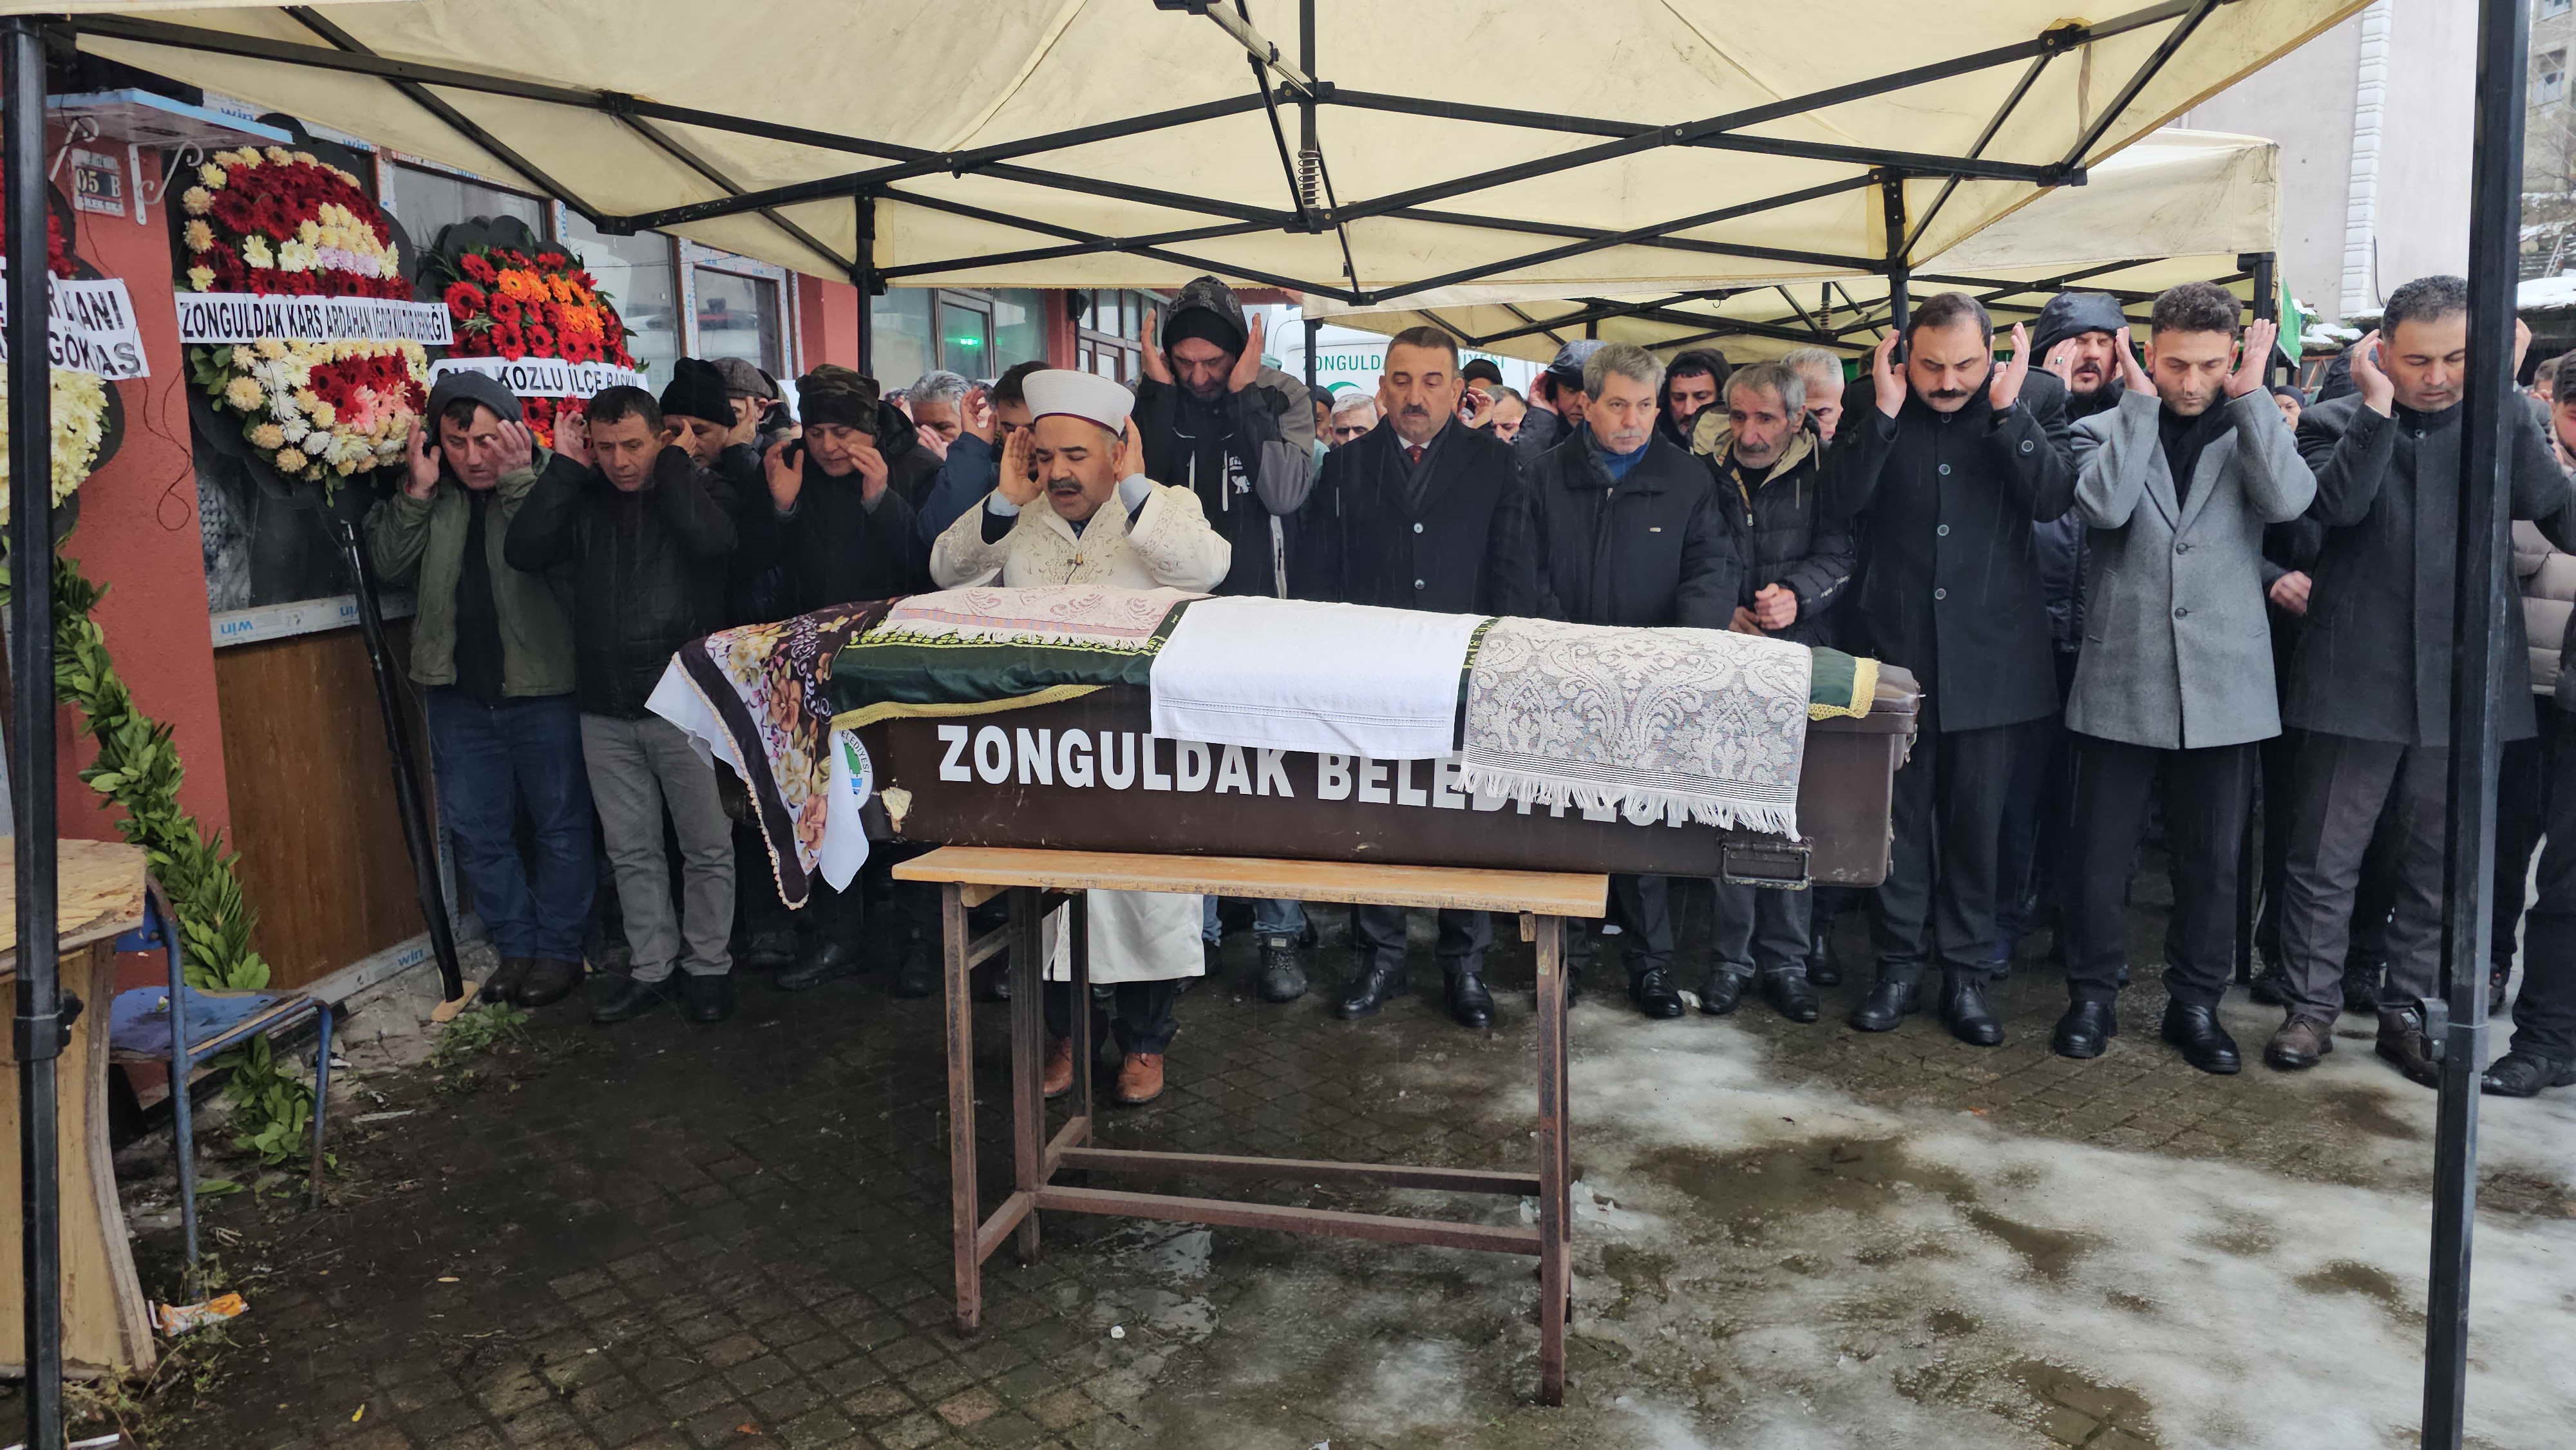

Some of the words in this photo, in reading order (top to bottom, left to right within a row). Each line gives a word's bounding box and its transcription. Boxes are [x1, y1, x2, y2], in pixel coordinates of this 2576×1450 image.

[180, 302, 285, 339] ZONGULDAK
[286, 303, 323, 339] KARS
[326, 305, 374, 339] ARDAHAN
[1303, 355, 1385, 371] ONGULD
[495, 366, 564, 391] KOZLU
[221, 619, 253, 635] win
[340, 605, 361, 617] in
[938, 725, 1294, 798] ZONGULDAK
[397, 947, 423, 966] win
